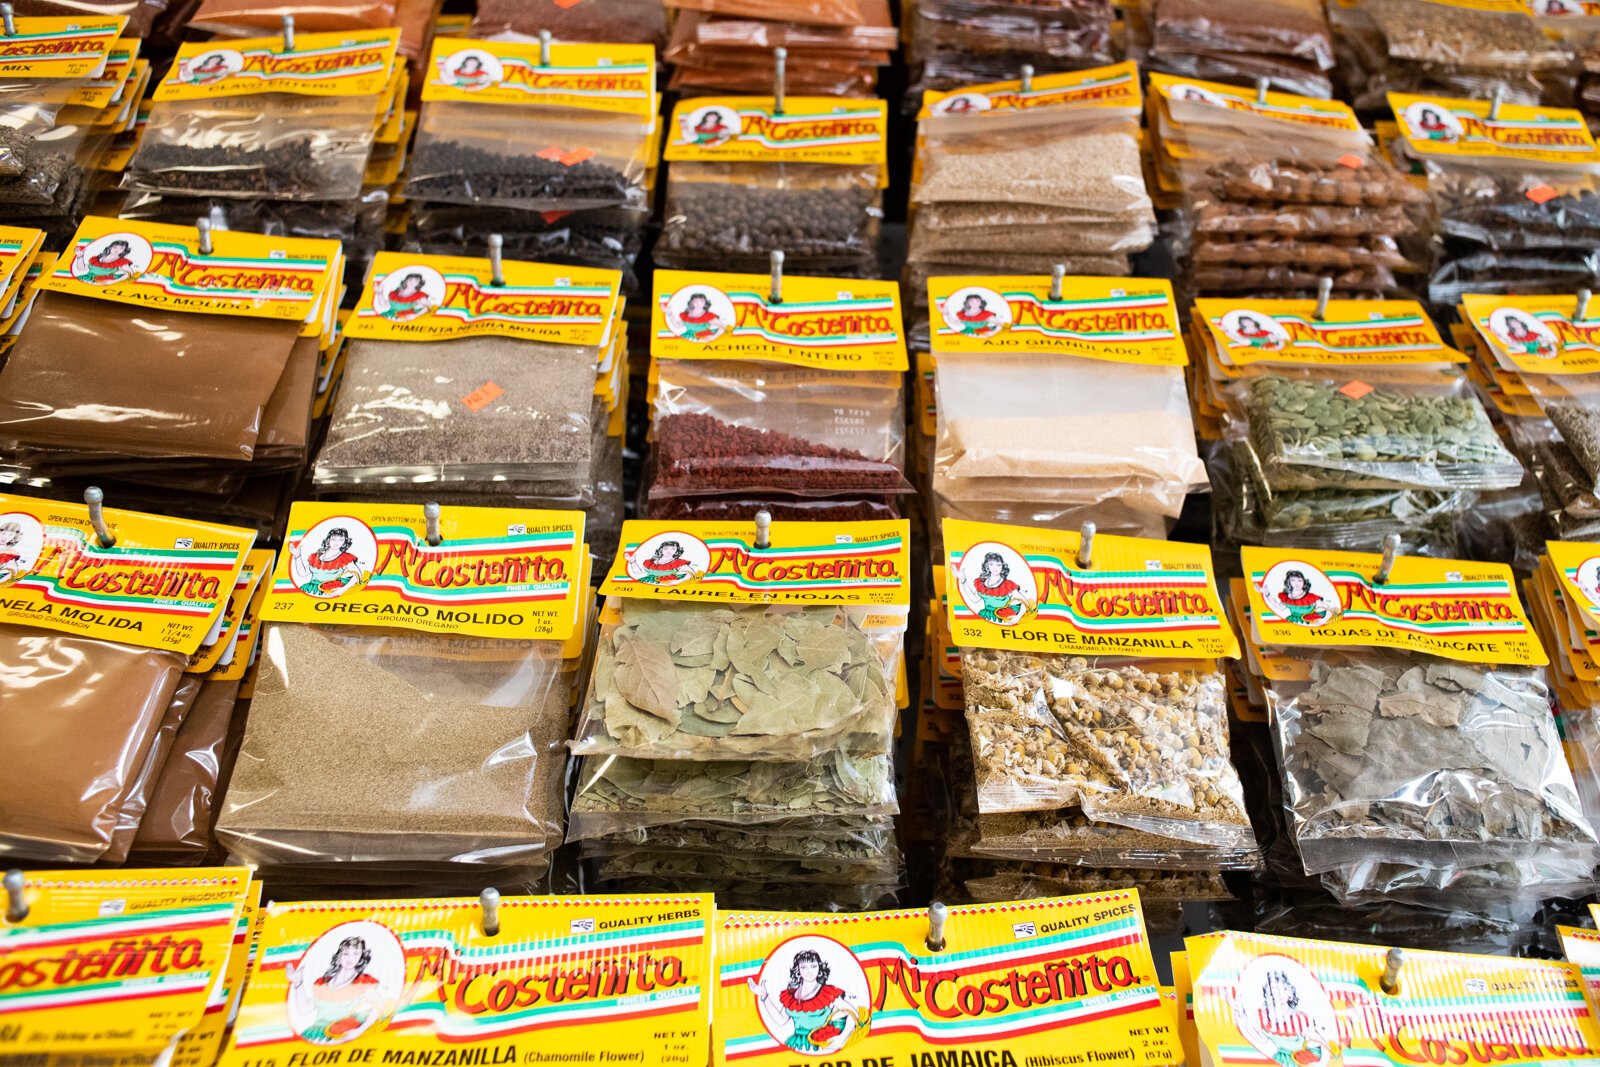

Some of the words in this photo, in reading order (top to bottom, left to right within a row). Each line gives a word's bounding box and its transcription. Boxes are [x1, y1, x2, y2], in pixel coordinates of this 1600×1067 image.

[770, 121, 876, 140] Costeñita
[146, 252, 192, 279] Mi
[181, 262, 315, 292] Costeñita
[101, 289, 168, 303] CLAVO
[173, 298, 251, 311] MOLIDO
[442, 282, 479, 310] Mi
[476, 293, 603, 316] Costeñita
[733, 302, 770, 329] Mi
[769, 312, 893, 336] Costeñita
[1008, 300, 1045, 325] Mi
[1045, 308, 1170, 332] Costeñita
[391, 323, 453, 333] PIMIENTA
[458, 322, 504, 332] NEGRA
[508, 325, 561, 336] MOLIDA
[703, 344, 783, 352] ACHIOTE
[787, 347, 862, 361] ENTERO
[1026, 339, 1141, 356] GRANULADO
[48, 515, 63, 523] OPEN
[64, 516, 85, 526] BOTTOM
[193, 541, 217, 550] QUALITY
[855, 535, 878, 543] QUALITY
[880, 531, 900, 539] SPICES
[32, 545, 83, 580] Mi
[66, 558, 221, 600] Costeñita
[375, 540, 420, 577] Mi
[413, 552, 567, 592] Costeñita
[712, 547, 750, 575] Mi
[747, 558, 899, 581] Costeñita
[654, 587, 742, 598] LAUREL
[1039, 568, 1073, 607] Mi
[1075, 588, 1213, 618] Costeñita
[1342, 582, 1377, 613] Mi
[1379, 593, 1517, 621] Costeñita
[7, 611, 43, 619] GROUND
[45, 615, 91, 629] CINNAMON
[60, 606, 143, 632] MOLIDA
[273, 602, 294, 610] 237
[314, 602, 429, 617] OREGANO
[436, 610, 524, 625] MOLIDO
[376, 615, 414, 623] GROUND
[415, 619, 459, 629] OREGANO
[162, 635, 182, 645] (35g)
[534, 625, 553, 634] (28g)
[963, 628, 982, 637] 332
[1000, 629, 1048, 642] FLOR
[1053, 633, 1076, 645] DE
[1082, 635, 1194, 649] MANZANILLA
[1310, 629, 1372, 637] HOJAS
[1376, 630, 1402, 639] DE
[1407, 633, 1501, 653] AGUACATE
[130, 899, 177, 910] QUALITY
[598, 915, 654, 929] QUALITY
[657, 909, 701, 922] HERBS
[1040, 915, 1089, 933] QUALITY
[1093, 903, 1136, 921] SPICES
[404, 946, 463, 1004] Mi
[455, 952, 689, 1015] Costeñita
[872, 955, 921, 1011] Mi
[923, 954, 1141, 1018] Costeñita
[1129, 1028, 1150, 1036] NET
[1153, 1026, 1170, 1034] WT
[287, 1050, 342, 1067] FLOR
[347, 1048, 379, 1064] DE
[382, 1045, 517, 1067] MANZANILLA
[523, 1051, 595, 1066] (Chamomile
[599, 1049, 645, 1062] Flower)
[1024, 1053, 1084, 1067] (Hibiscus
[1086, 1047, 1136, 1063] Flower)
